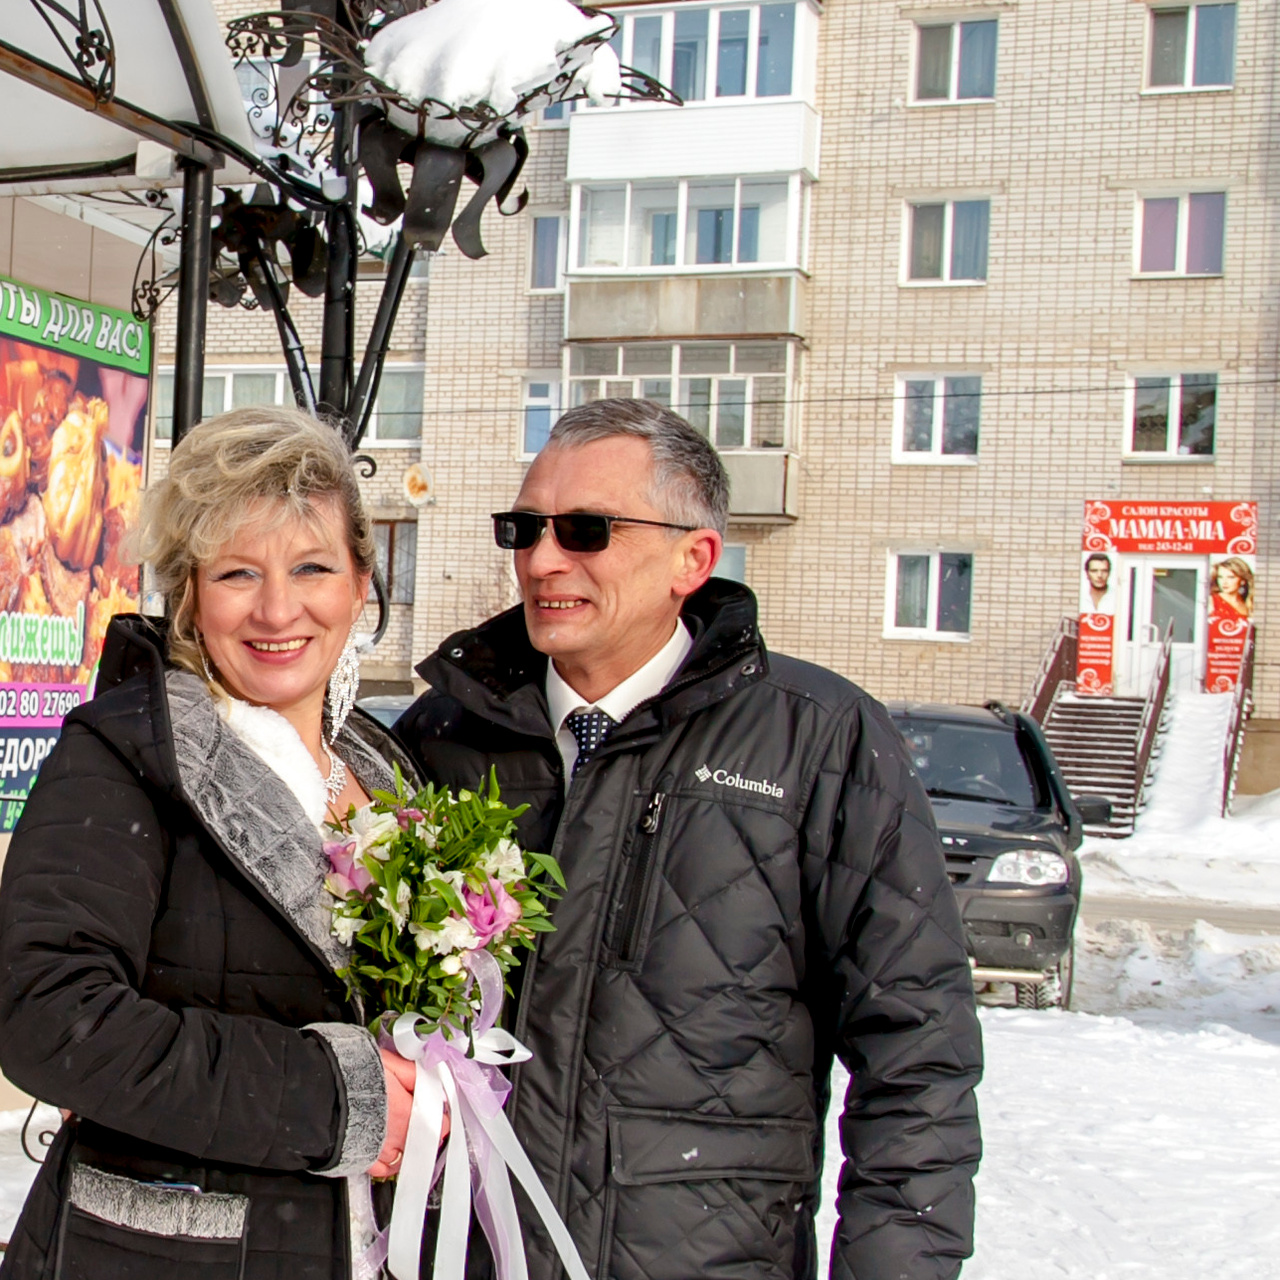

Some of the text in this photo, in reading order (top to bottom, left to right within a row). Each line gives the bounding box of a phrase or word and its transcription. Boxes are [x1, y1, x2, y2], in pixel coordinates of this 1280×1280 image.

[42, 296, 95, 344] ДЛЯ
[95, 313, 144, 361] ВАС!
[1122, 506, 1209, 517] САЛОН КРАСОТЫ
[1108, 518, 1226, 541] MAMMA-MIA
[20, 690, 39, 717] 80
[712, 769, 785, 798] Columbia
